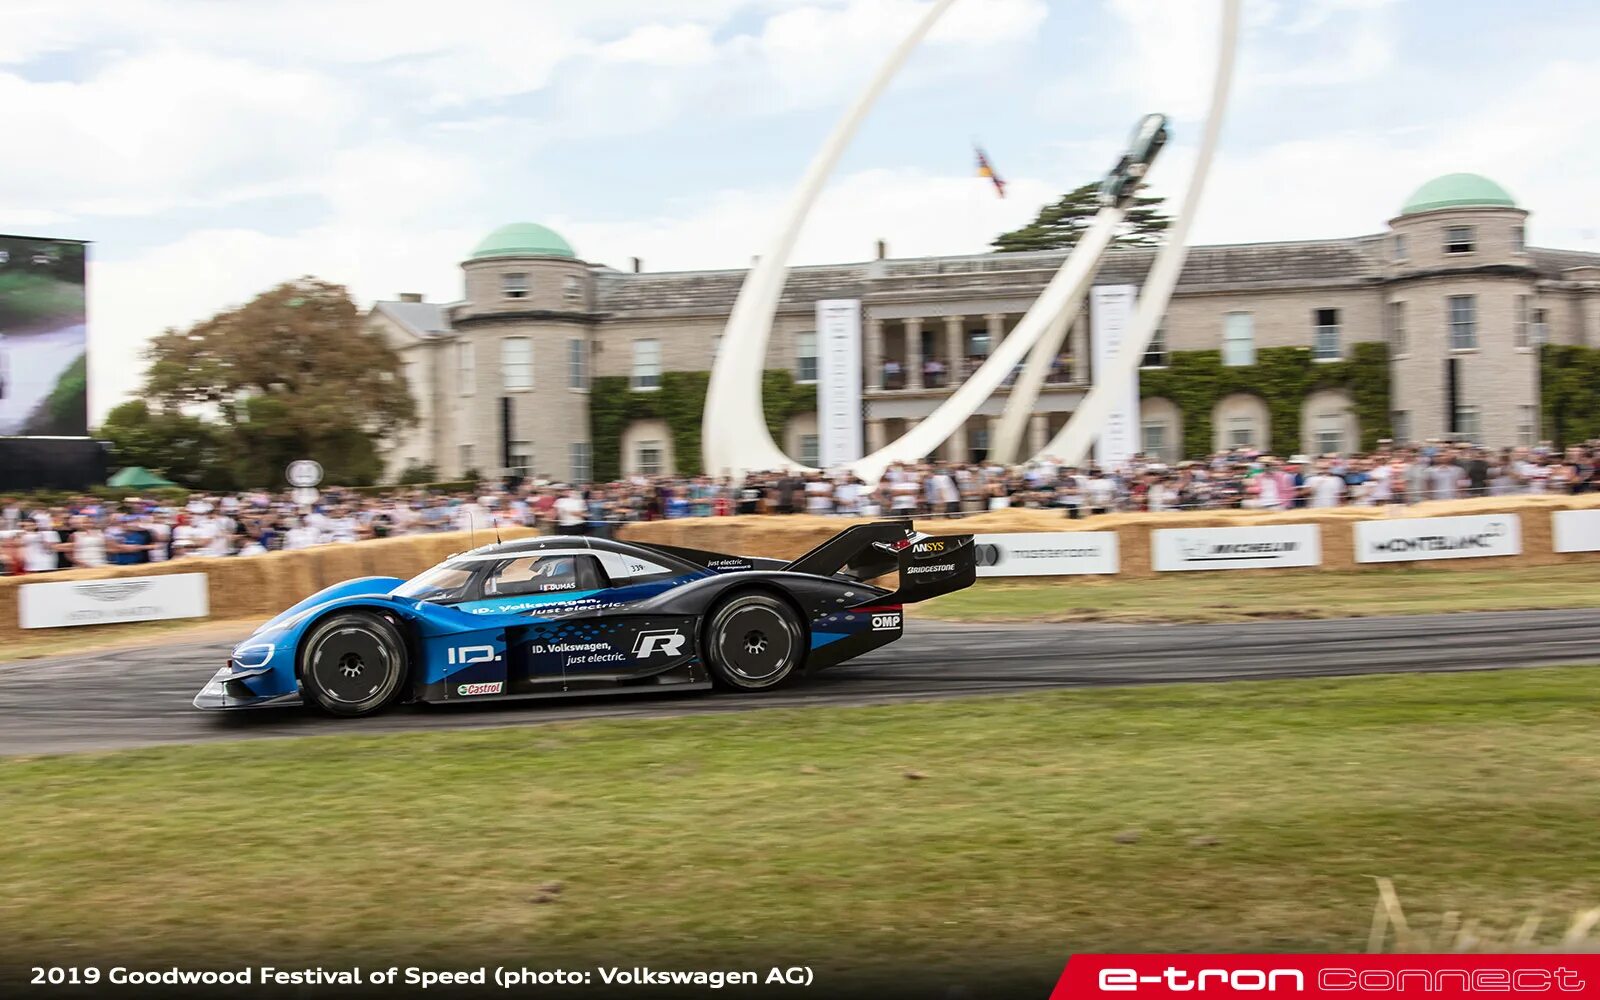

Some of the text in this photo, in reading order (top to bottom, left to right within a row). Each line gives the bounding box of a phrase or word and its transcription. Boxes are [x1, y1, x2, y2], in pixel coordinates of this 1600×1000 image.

[912, 542, 944, 553] ANSYS
[907, 564, 955, 574] BRIDGESTONE
[472, 599, 600, 615] ID. Volkswagen,
[872, 616, 901, 627] OMP
[532, 642, 612, 654] ID. Volkswagen,
[632, 629, 686, 659] R
[447, 645, 502, 665] ID.
[566, 652, 626, 666] just electric.
[468, 684, 500, 694] Castrol
